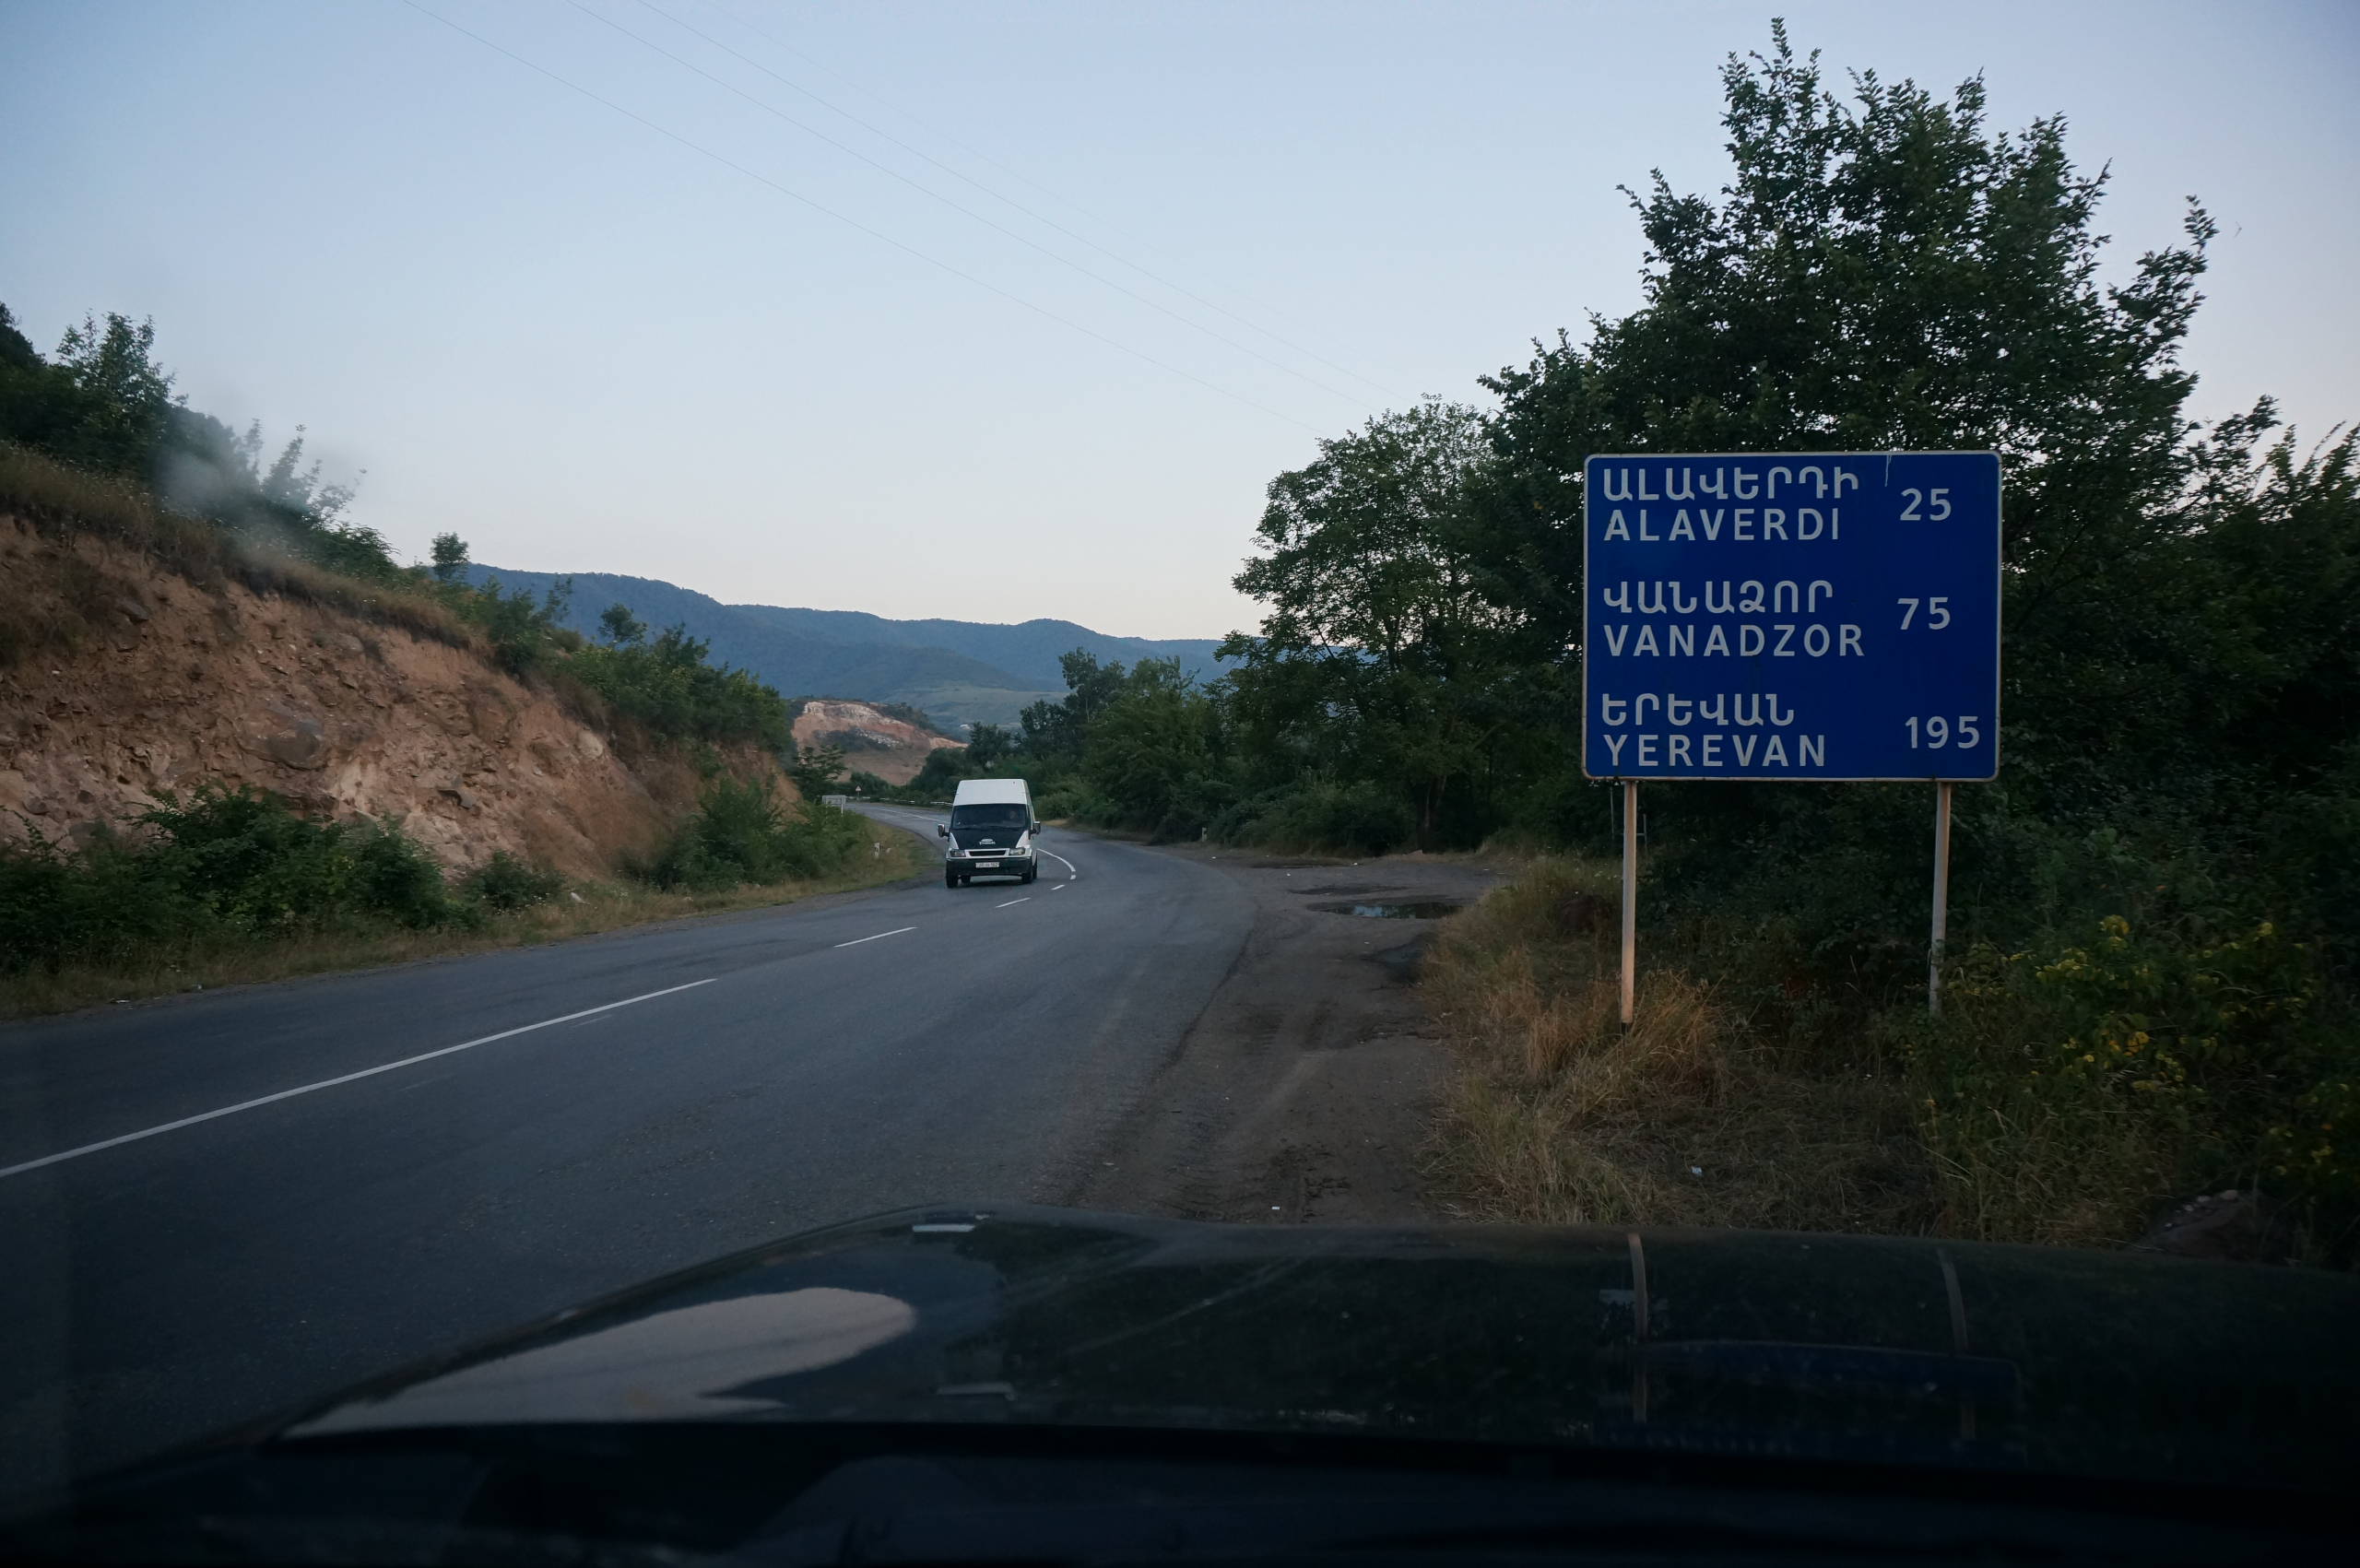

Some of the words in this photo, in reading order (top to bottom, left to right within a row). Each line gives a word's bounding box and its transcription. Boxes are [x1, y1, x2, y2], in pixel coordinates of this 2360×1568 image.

[1603, 466, 1858, 501] ԱԼԱՎԵՐԴԻ
[1899, 488, 1953, 522] 25
[1603, 507, 1839, 541] ALAVERDI
[1603, 580, 1834, 615] ՎԱՆԱՁՈՐ
[1896, 596, 1952, 631] 75
[1603, 623, 1865, 657] VANADZOR
[1601, 692, 1795, 727] ԵՐԵՎԱՆ
[1904, 715, 1980, 749] 195
[1603, 734, 1825, 767] YEREVAN
